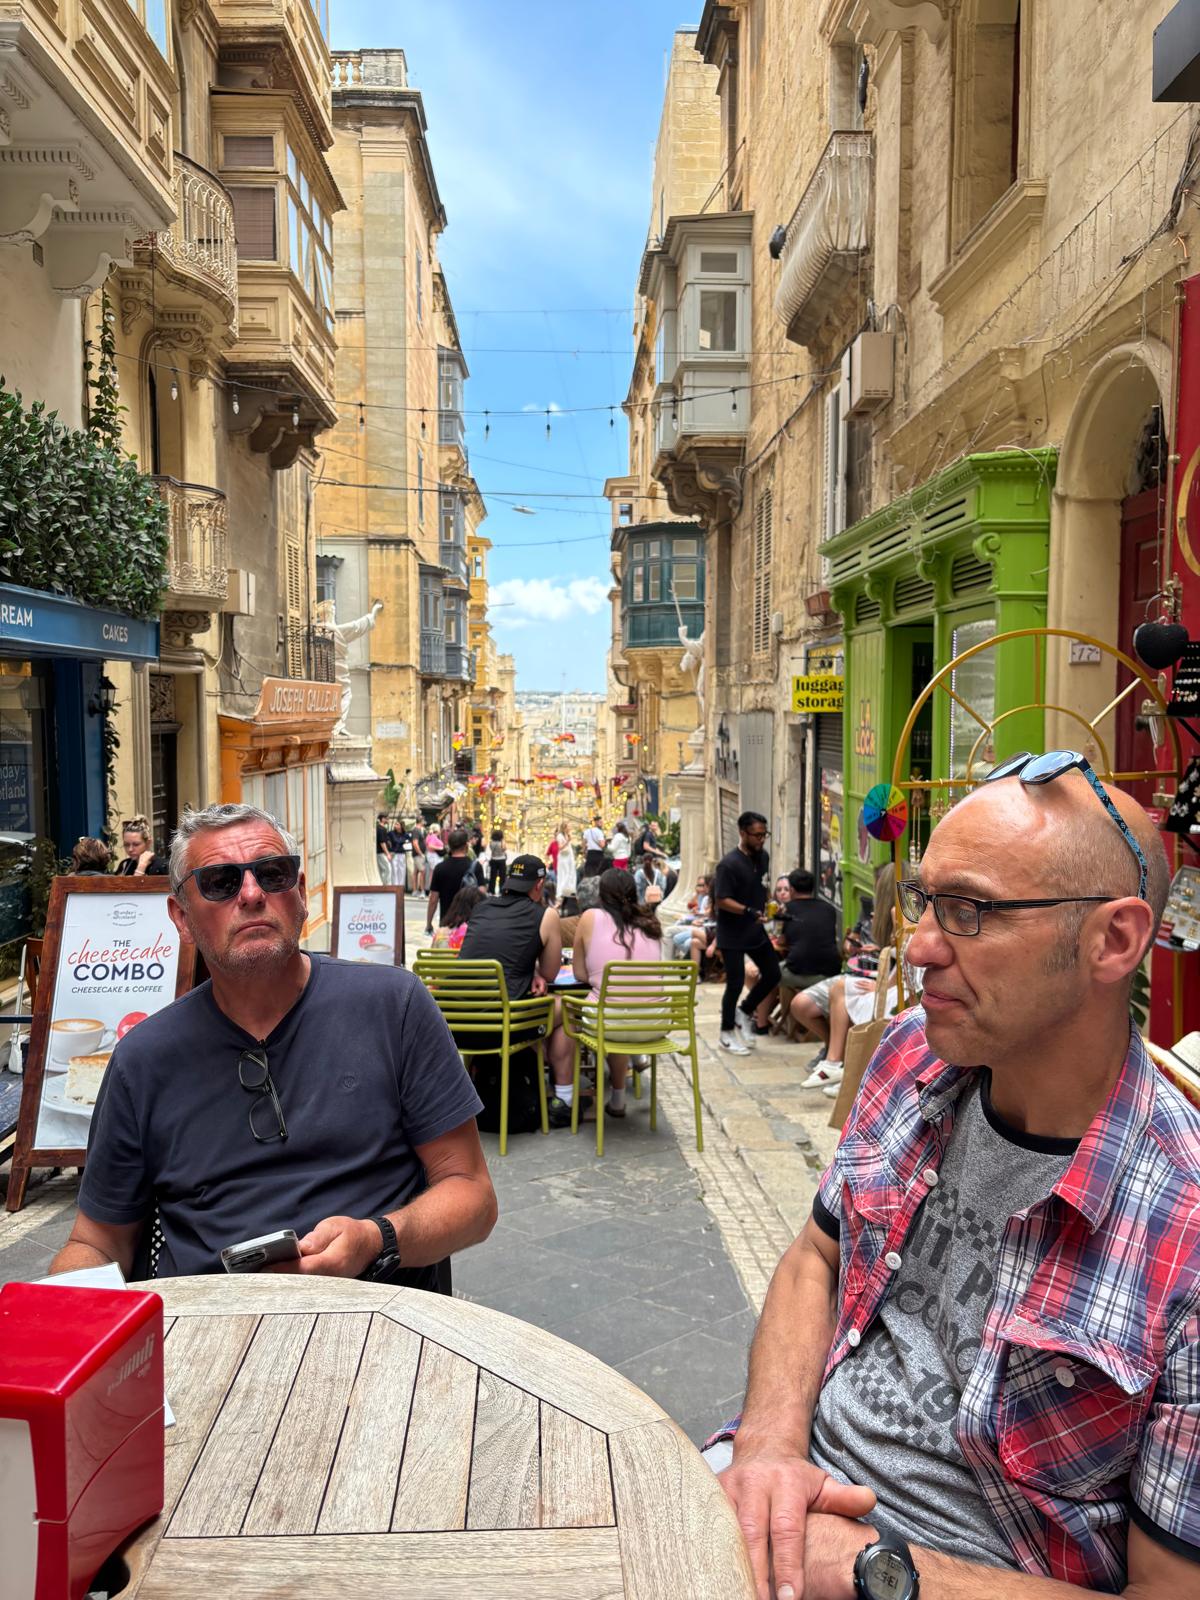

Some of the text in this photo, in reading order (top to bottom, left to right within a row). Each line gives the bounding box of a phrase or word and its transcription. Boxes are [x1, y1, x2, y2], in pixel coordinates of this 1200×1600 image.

[0, 604, 33, 628] REAM
[102, 623, 129, 643] CAKES
[270, 687, 305, 713] JOSEPH
[347, 922, 387, 930] COMBO
[68, 932, 173, 965] cheesecake
[73, 963, 164, 981] COMBO
[72, 986, 123, 994] CHEESECAKE
[132, 985, 163, 993] COFFEE
